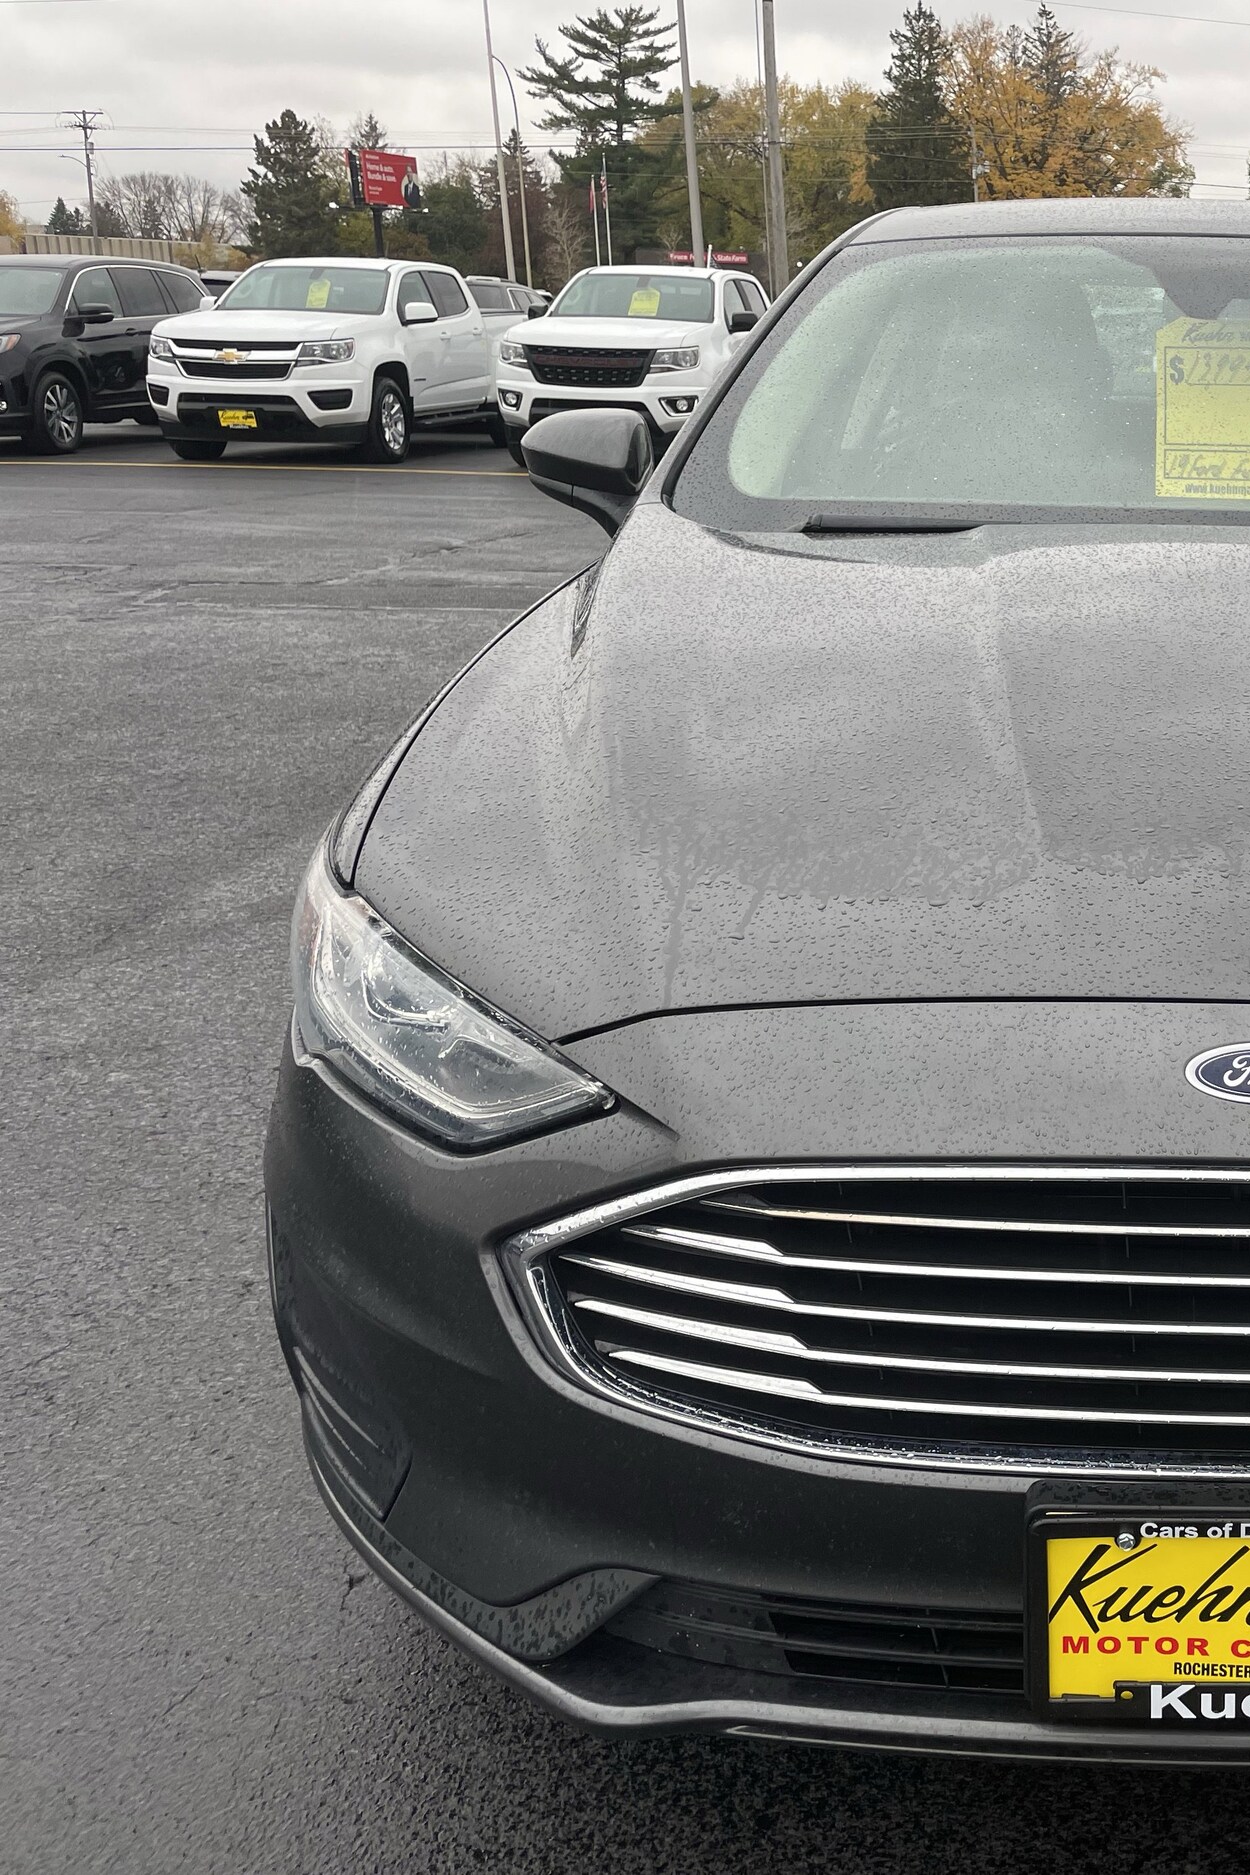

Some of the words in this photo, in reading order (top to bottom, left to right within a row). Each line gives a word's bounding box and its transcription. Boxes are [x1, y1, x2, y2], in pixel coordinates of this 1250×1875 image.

[1139, 1522, 1201, 1539] Cars
[1206, 1522, 1235, 1539] of
[1062, 1635, 1209, 1657] MOTOR
